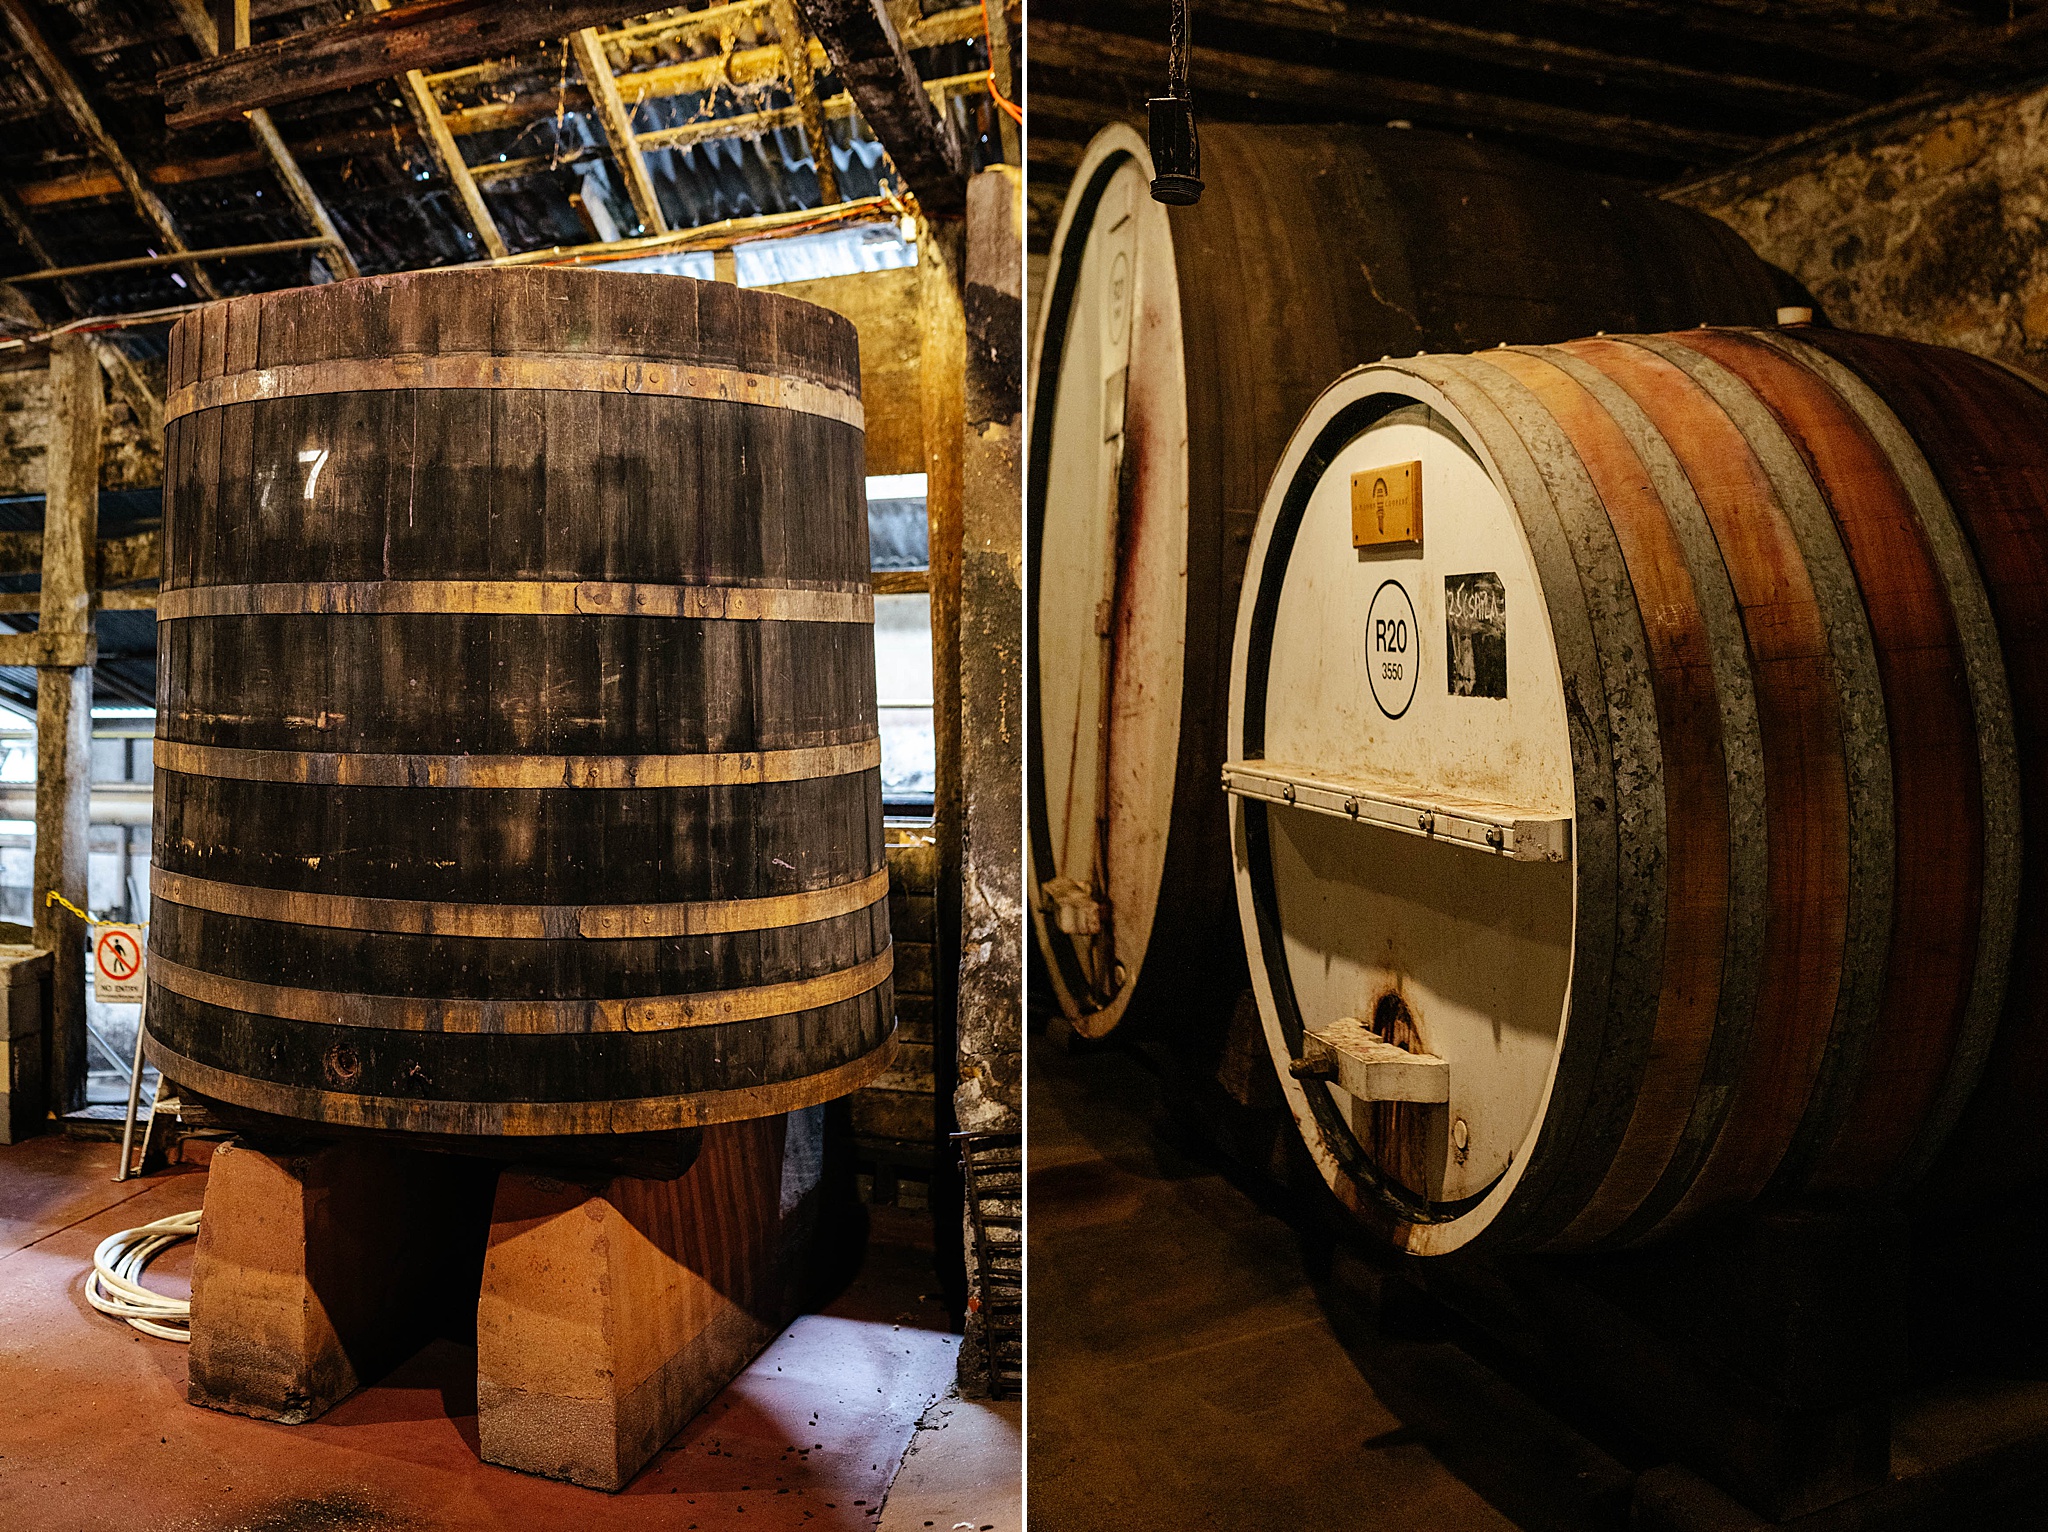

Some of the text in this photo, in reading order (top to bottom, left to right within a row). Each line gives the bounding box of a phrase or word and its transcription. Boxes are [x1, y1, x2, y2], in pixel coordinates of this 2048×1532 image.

[298, 449, 329, 500] 7
[1376, 619, 1408, 653] R20
[1382, 662, 1403, 681] 3550
[101, 984, 112, 992] NO
